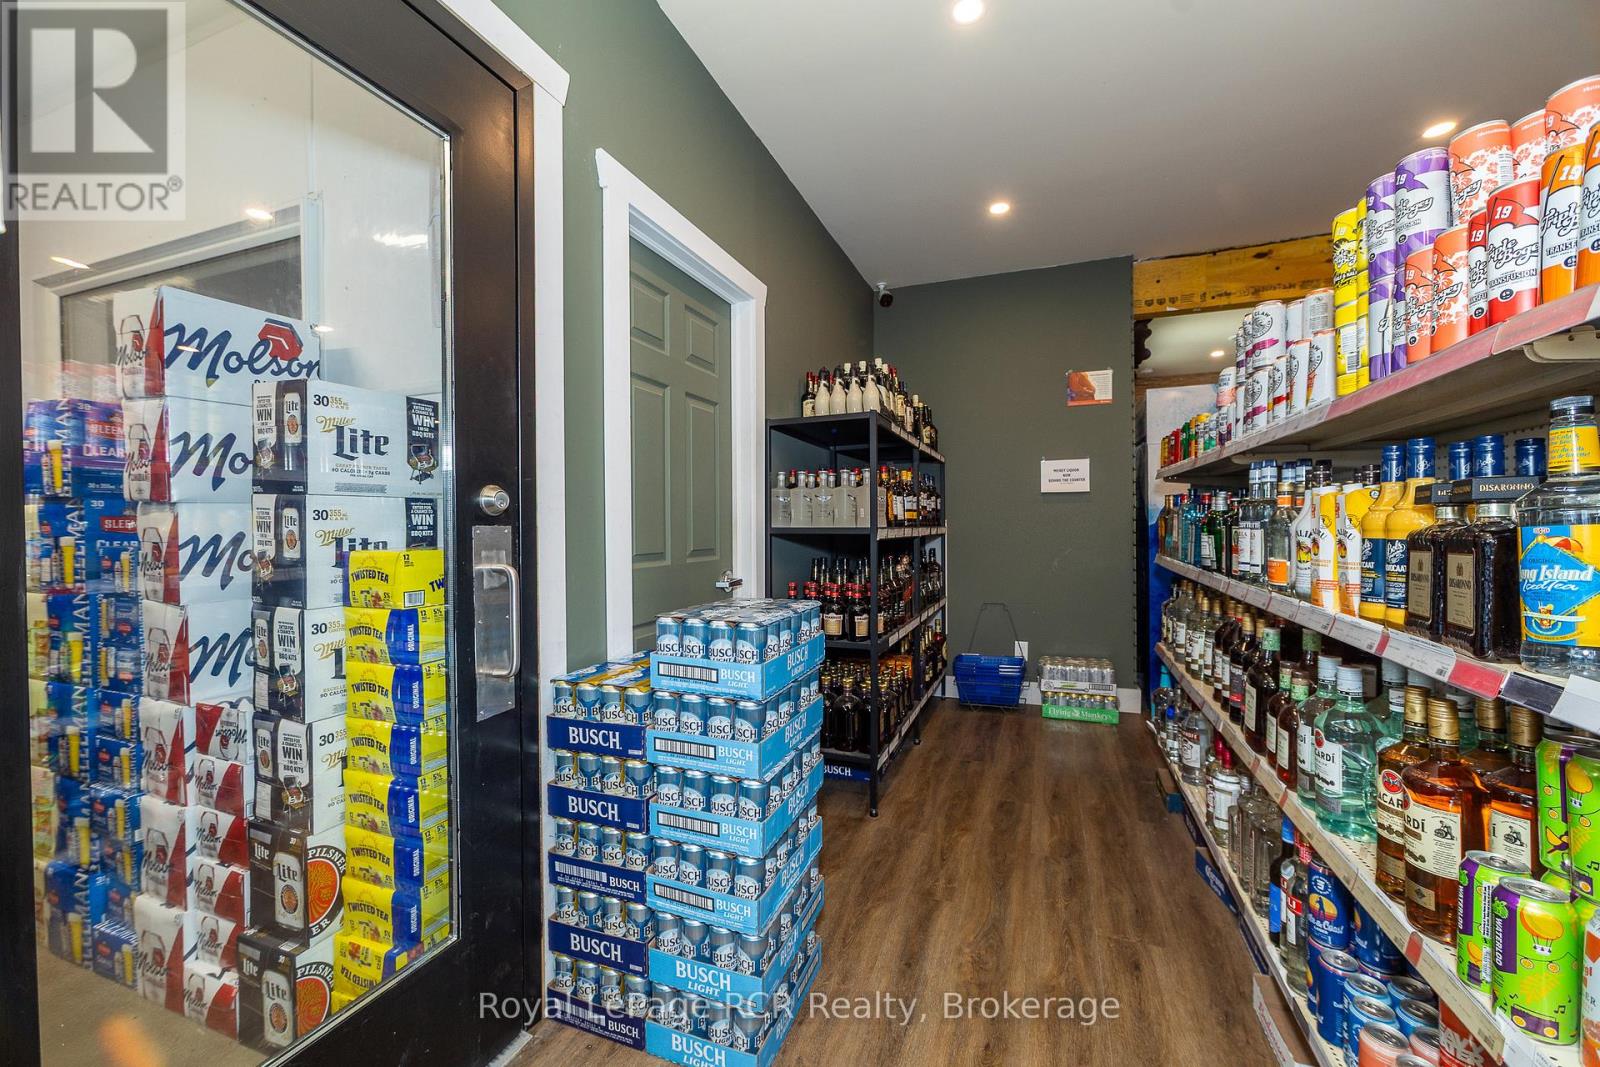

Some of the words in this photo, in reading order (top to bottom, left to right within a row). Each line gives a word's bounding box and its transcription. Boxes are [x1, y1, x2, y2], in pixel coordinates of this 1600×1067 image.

[1396, 173, 1407, 186] 19
[1559, 164, 1583, 182] 19
[1494, 205, 1513, 220] 19
[1470, 230, 1485, 243] 19
[163, 322, 321, 389] Molson
[313, 394, 330, 407] 30
[256, 408, 272, 422] WIN
[412, 413, 435, 428] WIN
[315, 415, 357, 433] Miller
[332, 424, 390, 461] Lite
[1479, 482, 1535, 493] DISARONNO
[312, 509, 329, 521] 30
[411, 513, 434, 526] WIN
[256, 520, 272, 533] WIN
[315, 527, 356, 547] Miller
[351, 569, 376, 582] TWISTED
[377, 571, 389, 585] TEA
[1539, 563, 1596, 582] Island
[1449, 577, 1472, 591] DISARONNO
[1522, 579, 1547, 593] Iced
[1545, 580, 1580, 592] Tea
[311, 622, 328, 635] 30
[349, 625, 372, 637] TWISTED
[372, 627, 383, 641] TEA
[278, 634, 296, 649] WIN
[787, 644, 809, 671] BUSCH
[720, 668, 756, 683] BUSCH
[352, 683, 377, 695] TWISTED
[377, 686, 389, 700] TEA
[727, 680, 748, 689] LIGHT
[785, 712, 807, 743] BUSCH
[319, 732, 335, 747] 30
[351, 738, 374, 752] TWISTED
[374, 742, 387, 755] TEA
[568, 726, 621, 750] BUSCH
[282, 745, 303, 762] WIN
[718, 745, 753, 761] BUSCH
[726, 758, 746, 767] LIGHT
[823, 764, 852, 777] BUSCH
[349, 794, 372, 807] TWISTED
[373, 798, 385, 812] TEA
[788, 781, 809, 816] BUSCH
[567, 795, 619, 823] BUSCH
[721, 822, 757, 840] BUSCH
[729, 835, 750, 845] LIGHT
[253, 842, 270, 860] Lite
[351, 847, 376, 860] TWISTED
[377, 851, 390, 866] TEA
[276, 862, 298, 882] Lite
[609, 876, 641, 893] BUSCH
[348, 902, 374, 914] TWISTED
[375, 906, 389, 921] TEA
[716, 899, 751, 918] BUSCH
[723, 911, 744, 922] LIGHT
[570, 932, 622, 963] BUSCH
[1495, 916, 1503, 967] WATERLOO
[242, 958, 259, 977] Lite
[675, 960, 731, 992] BUSCH
[264, 980, 287, 1000] Lite
[687, 981, 720, 998] LIGHT
[607, 1019, 639, 1039] BUSCH
[671, 1032, 727, 1067] BUSCH
